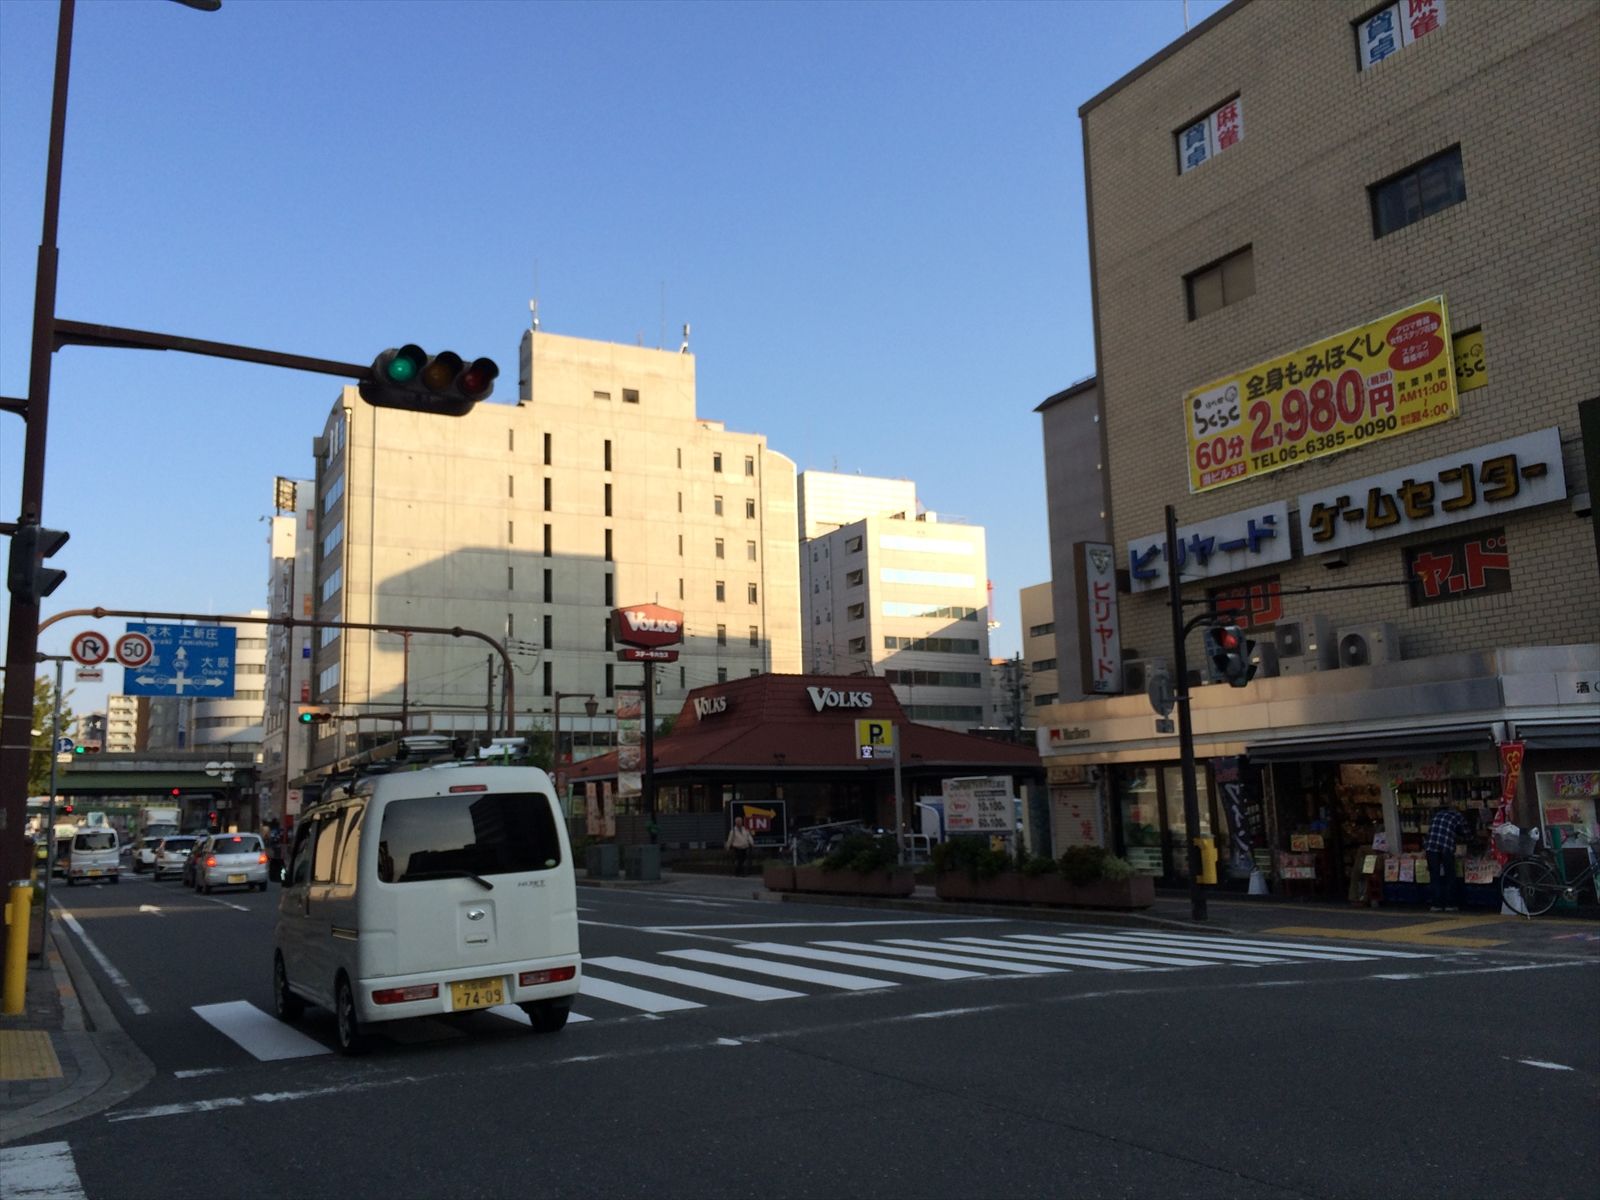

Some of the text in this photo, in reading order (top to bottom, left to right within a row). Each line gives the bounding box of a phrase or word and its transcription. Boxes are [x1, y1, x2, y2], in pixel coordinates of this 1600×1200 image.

[1217, 101, 1240, 150] 麻雀
[1246, 333, 1385, 402] 全身もみほぐし
[1397, 368, 1447, 392] 営業時間
[1399, 380, 1448, 405] AM11:00
[1195, 404, 1240, 435] らくらく
[1196, 434, 1245, 471] 60分
[1309, 453, 1547, 540] ゲームセンター
[1130, 514, 1277, 580] ビリヤード
[179, 628, 218, 640] 上新庄
[1093, 581, 1113, 679] ビリヤード
[123, 642, 144, 657] 50
[201, 657, 229, 669] 大阪
[1576, 681, 1590, 694] 酒
[869, 724, 883, 744] P
[748, 818, 767, 829] IN
[464, 989, 501, 1006] 74-09
